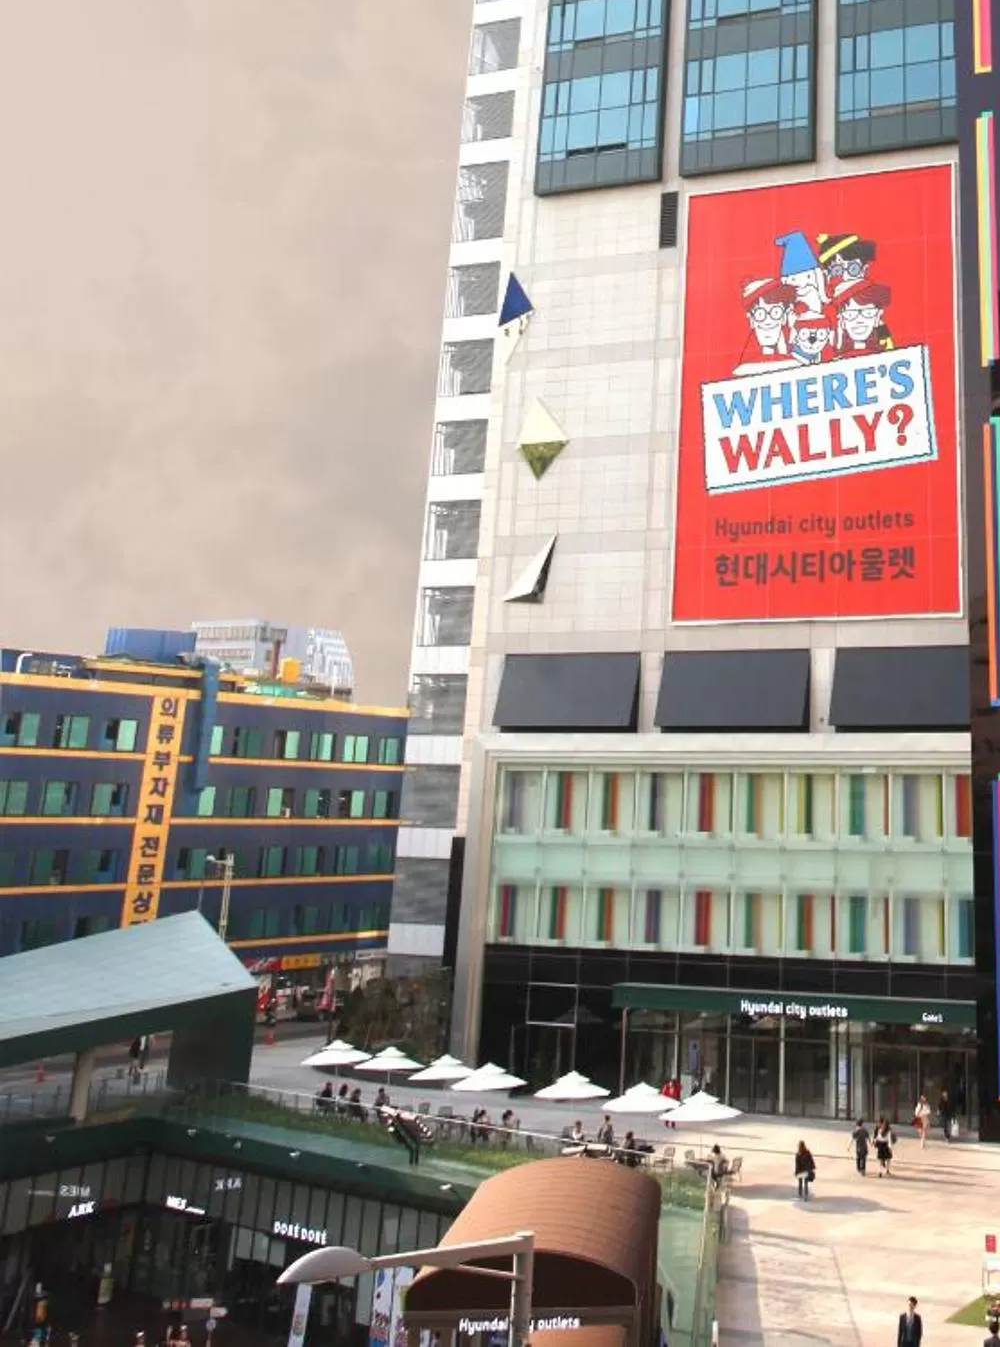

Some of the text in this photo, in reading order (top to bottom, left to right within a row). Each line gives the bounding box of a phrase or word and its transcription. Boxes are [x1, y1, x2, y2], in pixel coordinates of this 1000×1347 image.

[713, 358, 915, 429] WHERE'S
[718, 404, 915, 474] WALLY?
[715, 510, 915, 542] Hyundai city outlets
[714, 546, 916, 587] 현대시티아울렛
[130, 836, 160, 924] 전문상
[741, 999, 848, 1020] Hyundai city outlets
[537, 1316, 580, 1329] outlets
